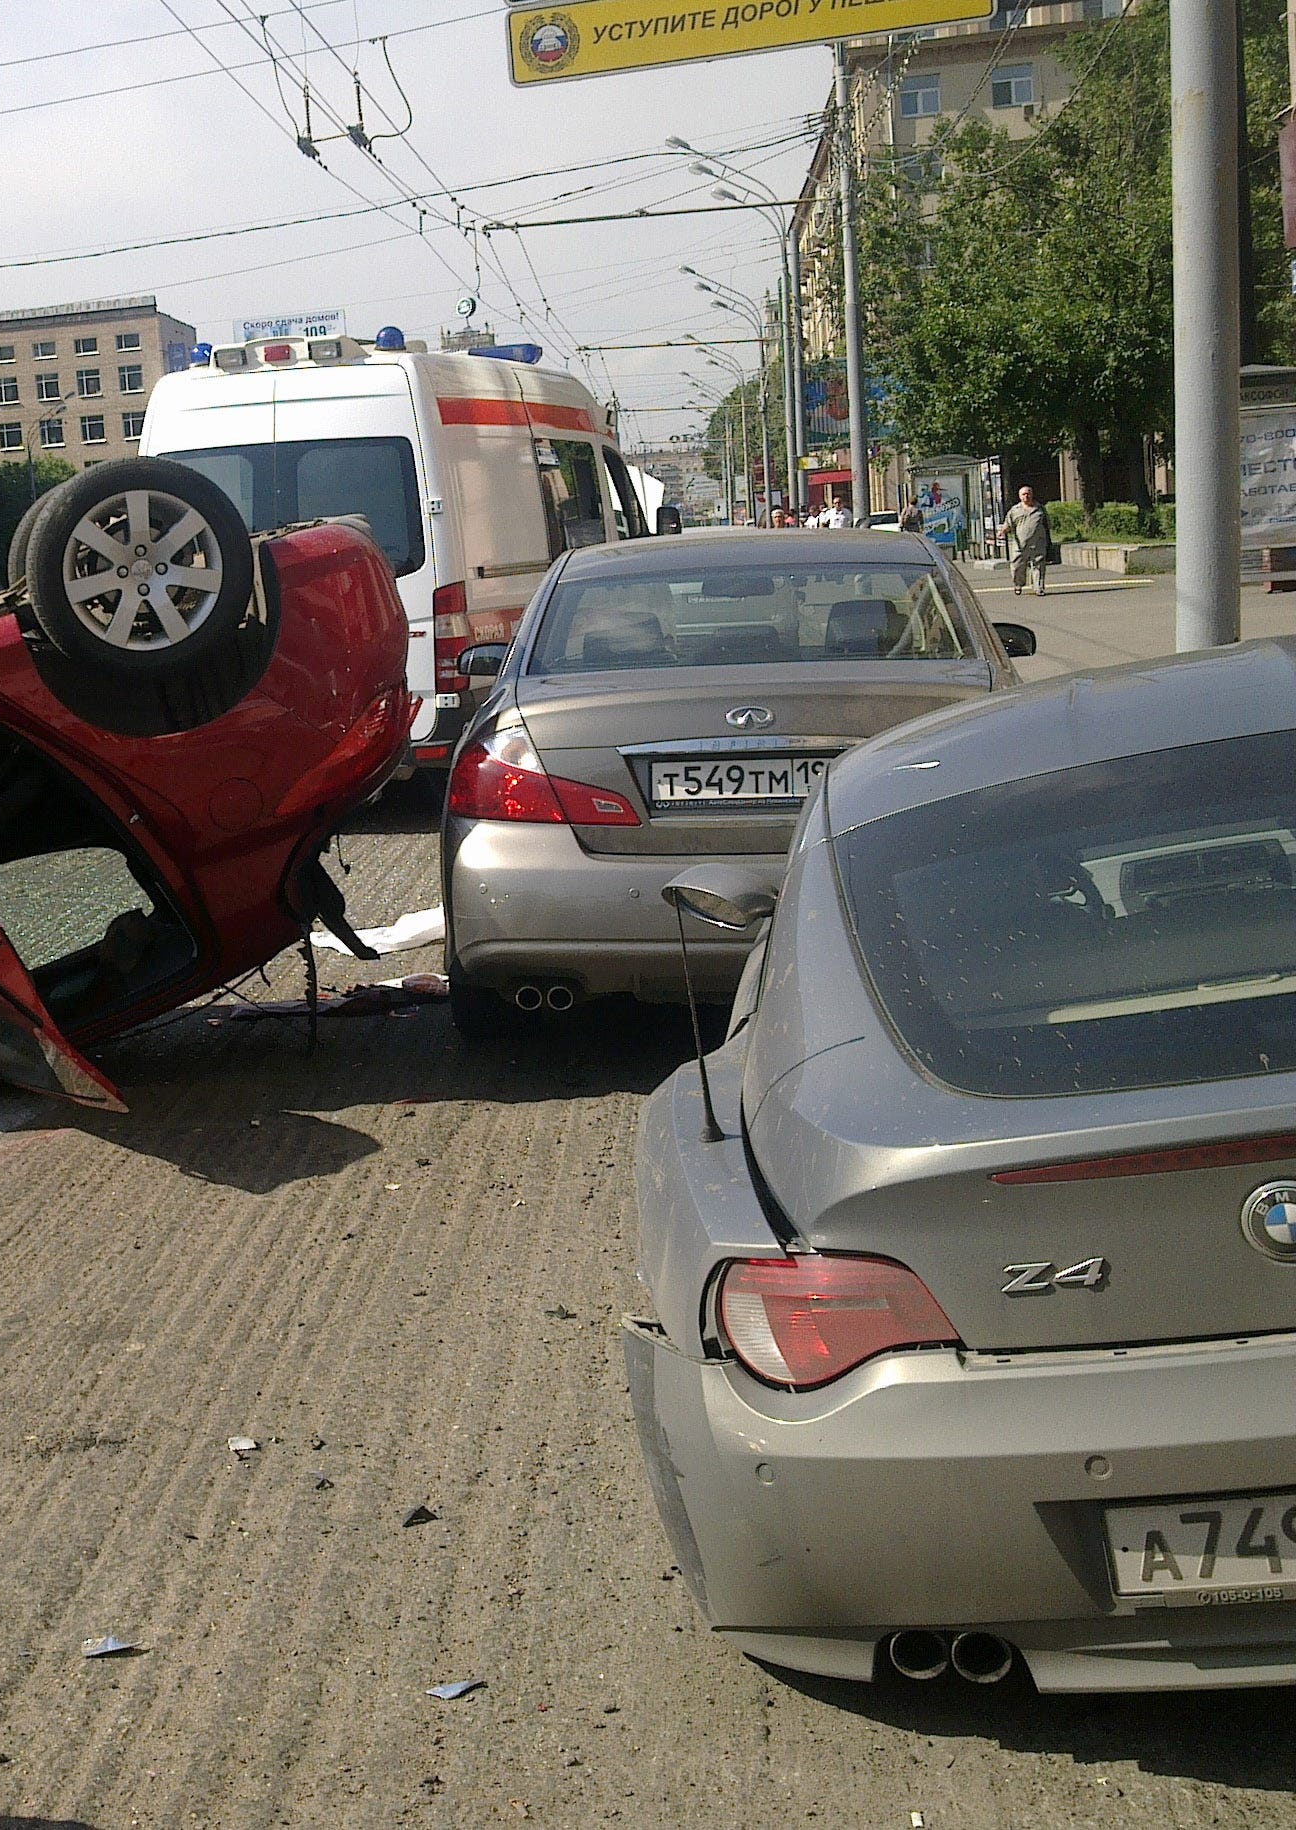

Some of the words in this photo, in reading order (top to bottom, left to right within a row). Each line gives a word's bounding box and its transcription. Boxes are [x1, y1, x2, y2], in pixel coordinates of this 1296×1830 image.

[593, 10, 717, 44] УСТУПИТЕ
[474, 623, 505, 642] СКОРАЯ
[1001, 1256, 1106, 1293] Z4
